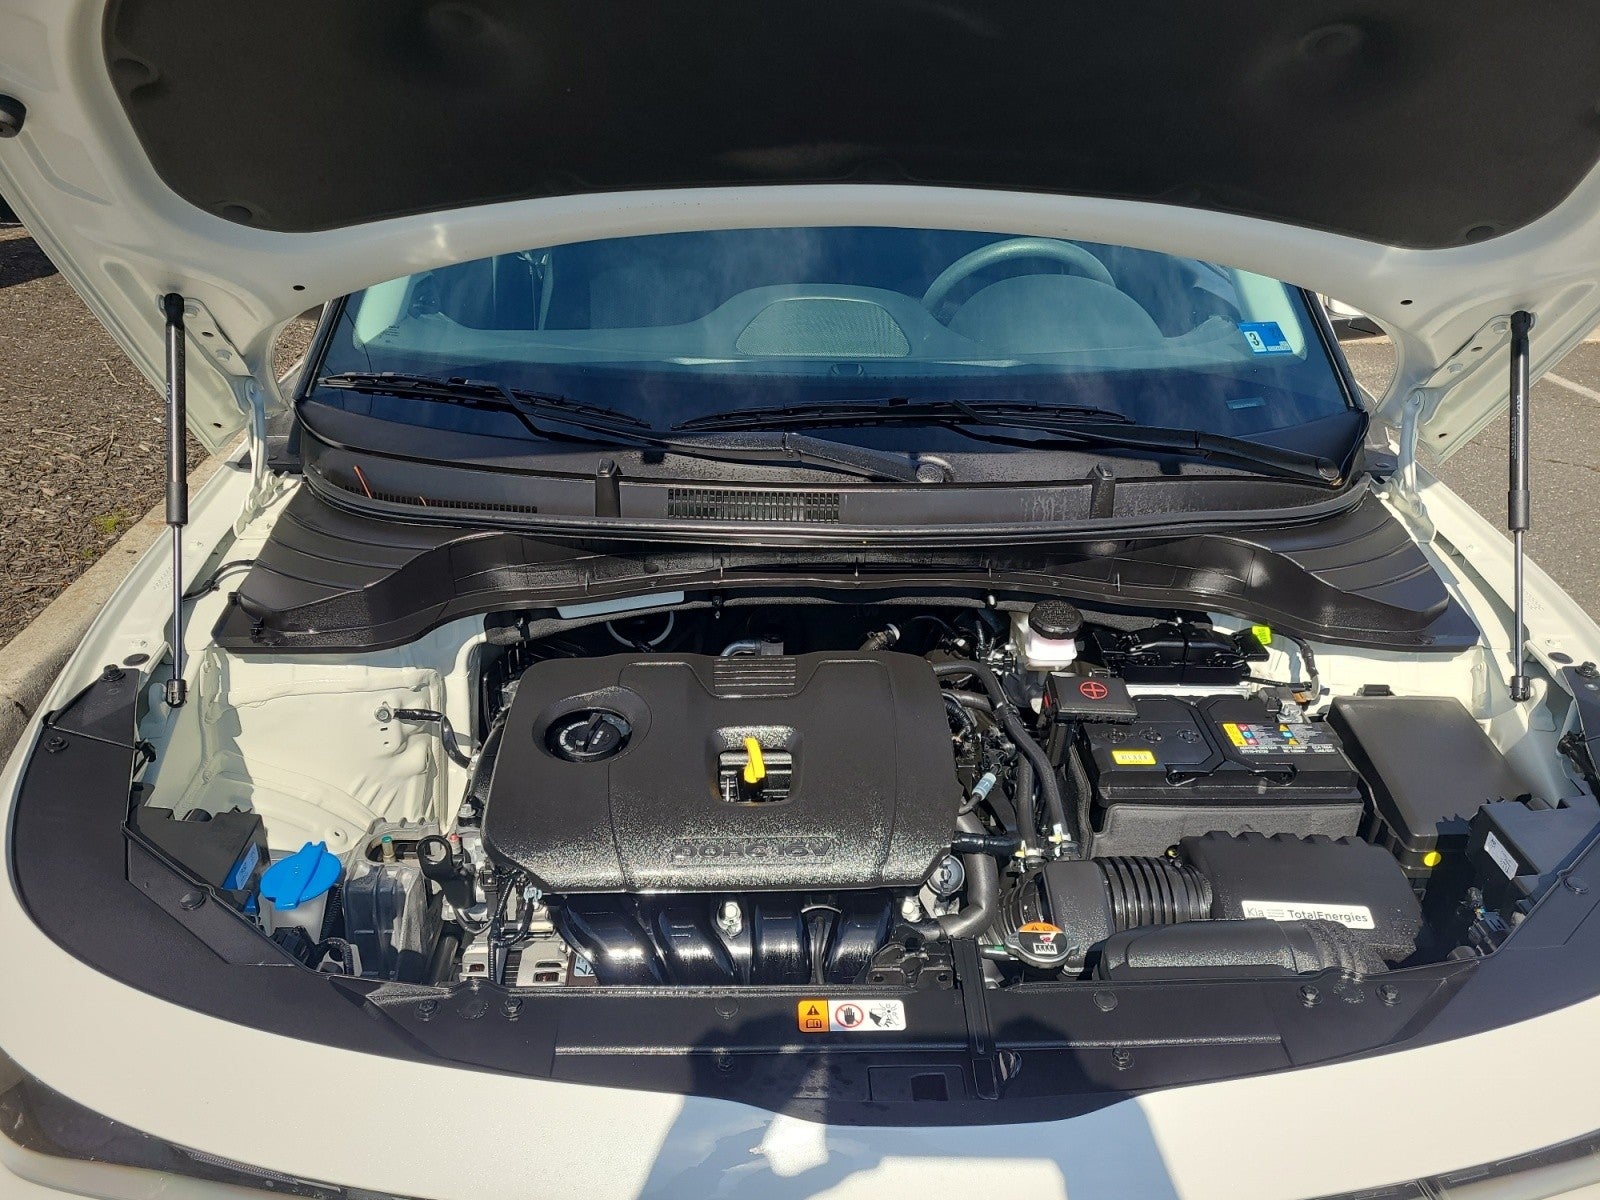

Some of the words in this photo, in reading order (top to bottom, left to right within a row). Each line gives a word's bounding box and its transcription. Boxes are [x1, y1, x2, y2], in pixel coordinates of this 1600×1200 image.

[1249, 332, 1260, 346] 3
[675, 843, 768, 858] DOHC
[777, 842, 832, 857] 16V
[1247, 907, 1265, 917] Kia
[1287, 909, 1369, 923] TotalEnergies
